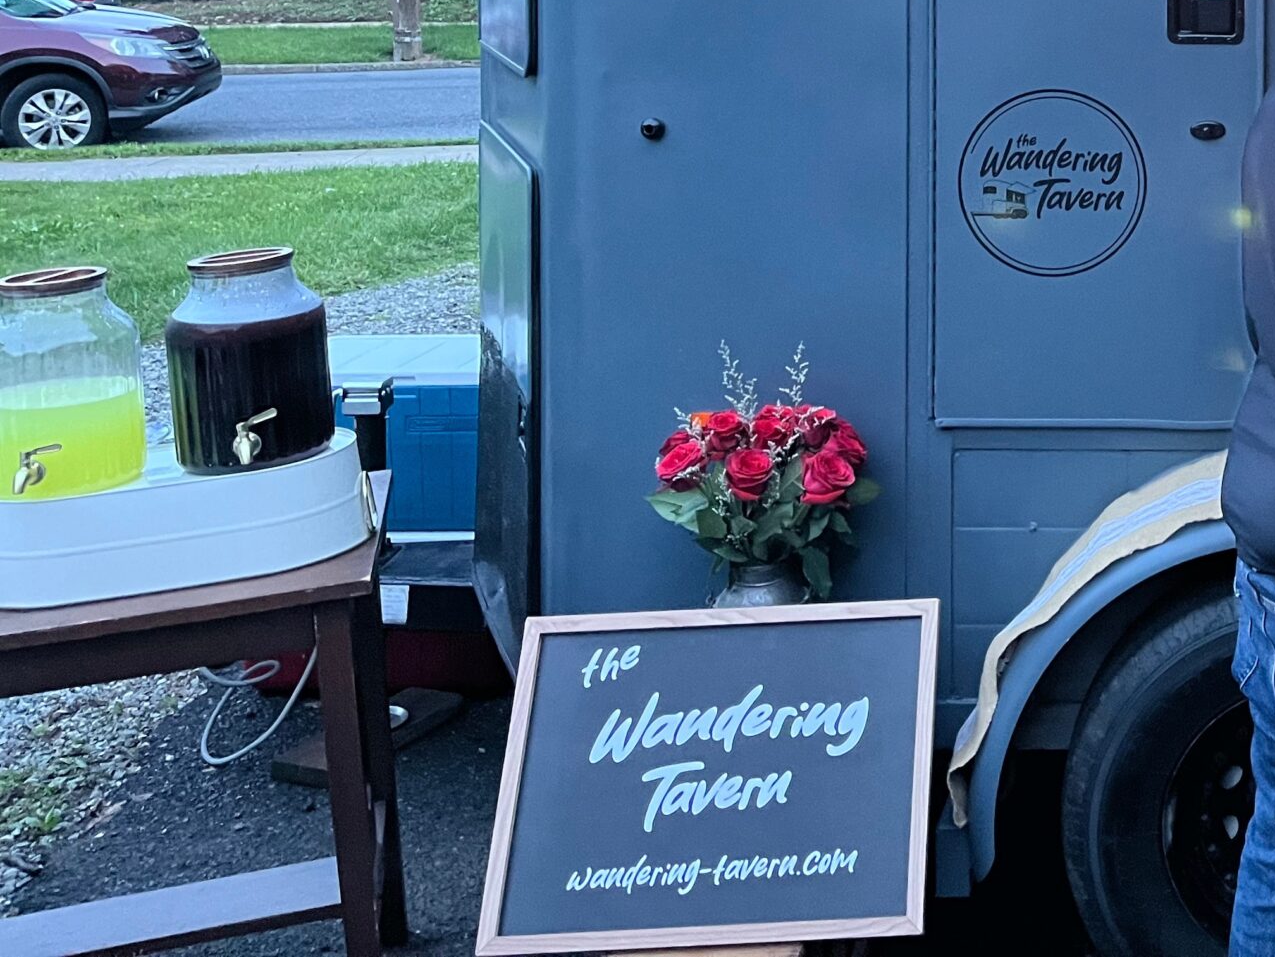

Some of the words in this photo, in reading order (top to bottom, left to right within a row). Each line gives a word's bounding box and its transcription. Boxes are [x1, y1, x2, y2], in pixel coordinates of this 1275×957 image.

[979, 137, 1123, 185] Wandering
[1016, 133, 1037, 149] the
[1033, 178, 1125, 220] Tavern
[581, 644, 641, 688] the
[588, 684, 870, 764] Wandering
[641, 761, 793, 833] Tavern
